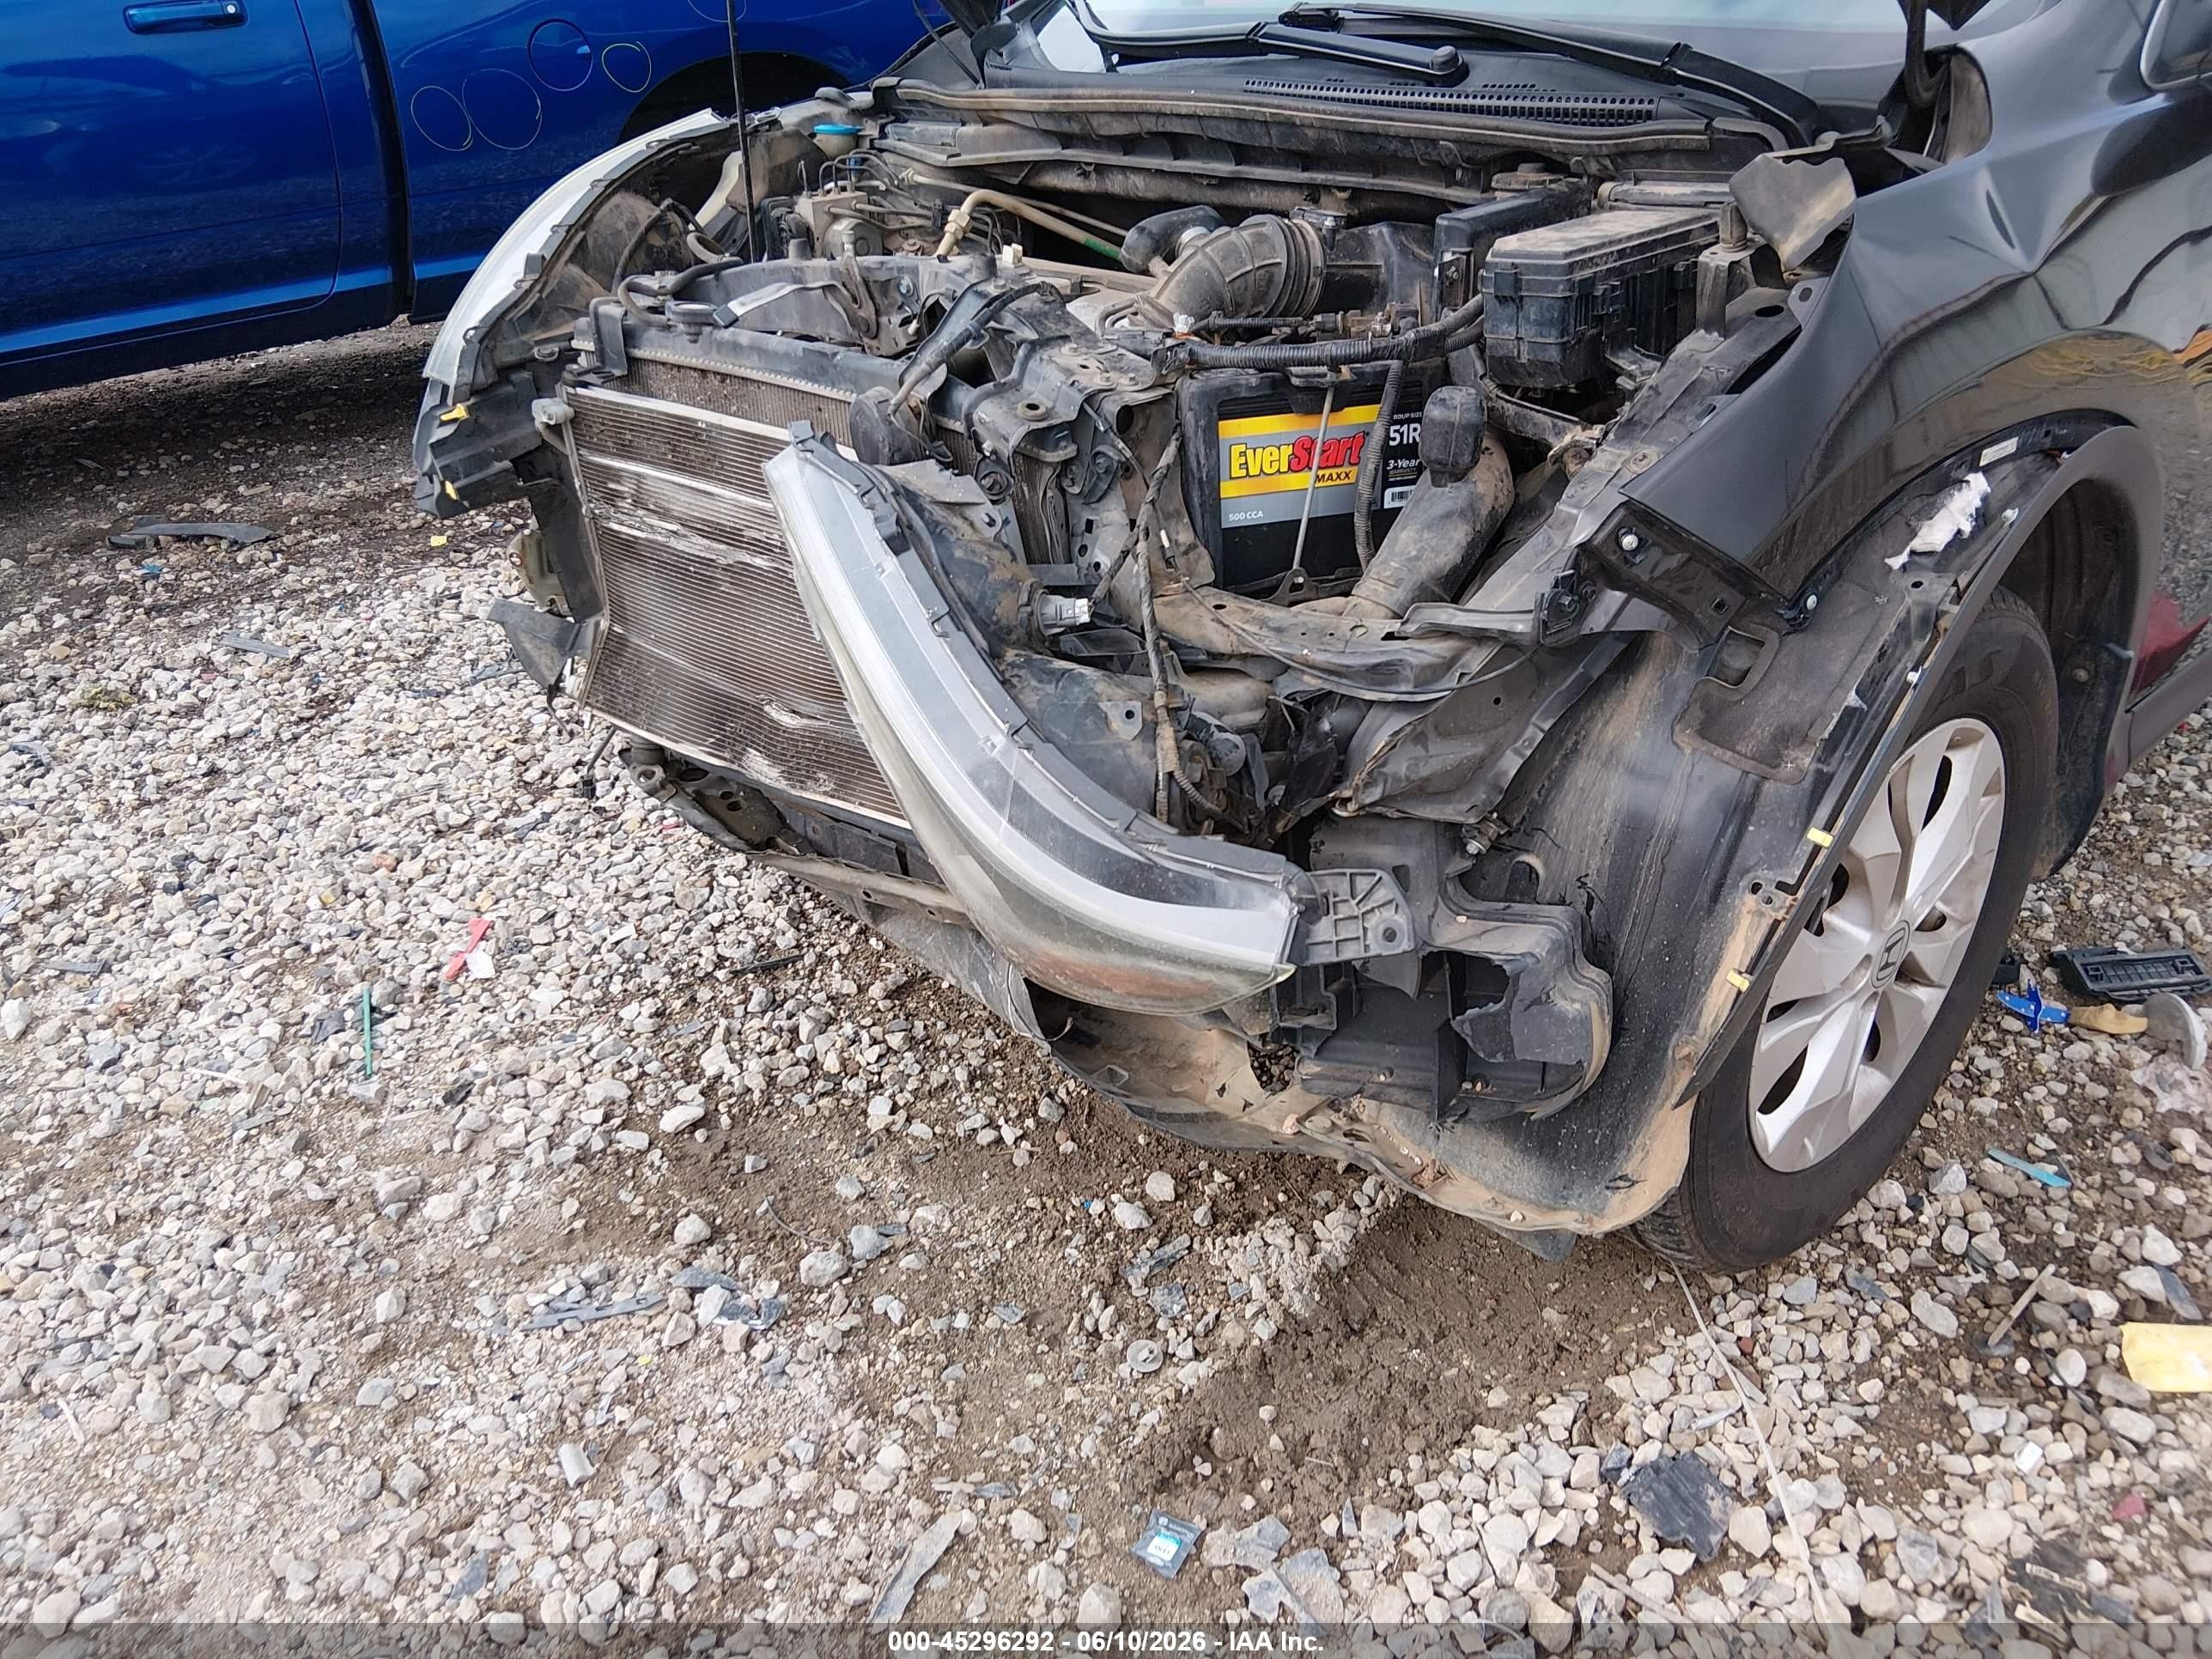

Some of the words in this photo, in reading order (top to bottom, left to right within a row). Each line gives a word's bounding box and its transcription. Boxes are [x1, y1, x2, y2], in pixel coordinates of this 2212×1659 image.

[1393, 412, 1410, 421] ROUP
[1389, 422, 1421, 447] 51R
[1386, 458, 1421, 471] 3-Year
[1316, 470, 1352, 483] MAXX
[1229, 512, 1246, 522] 500
[1246, 510, 1264, 520] CCA
